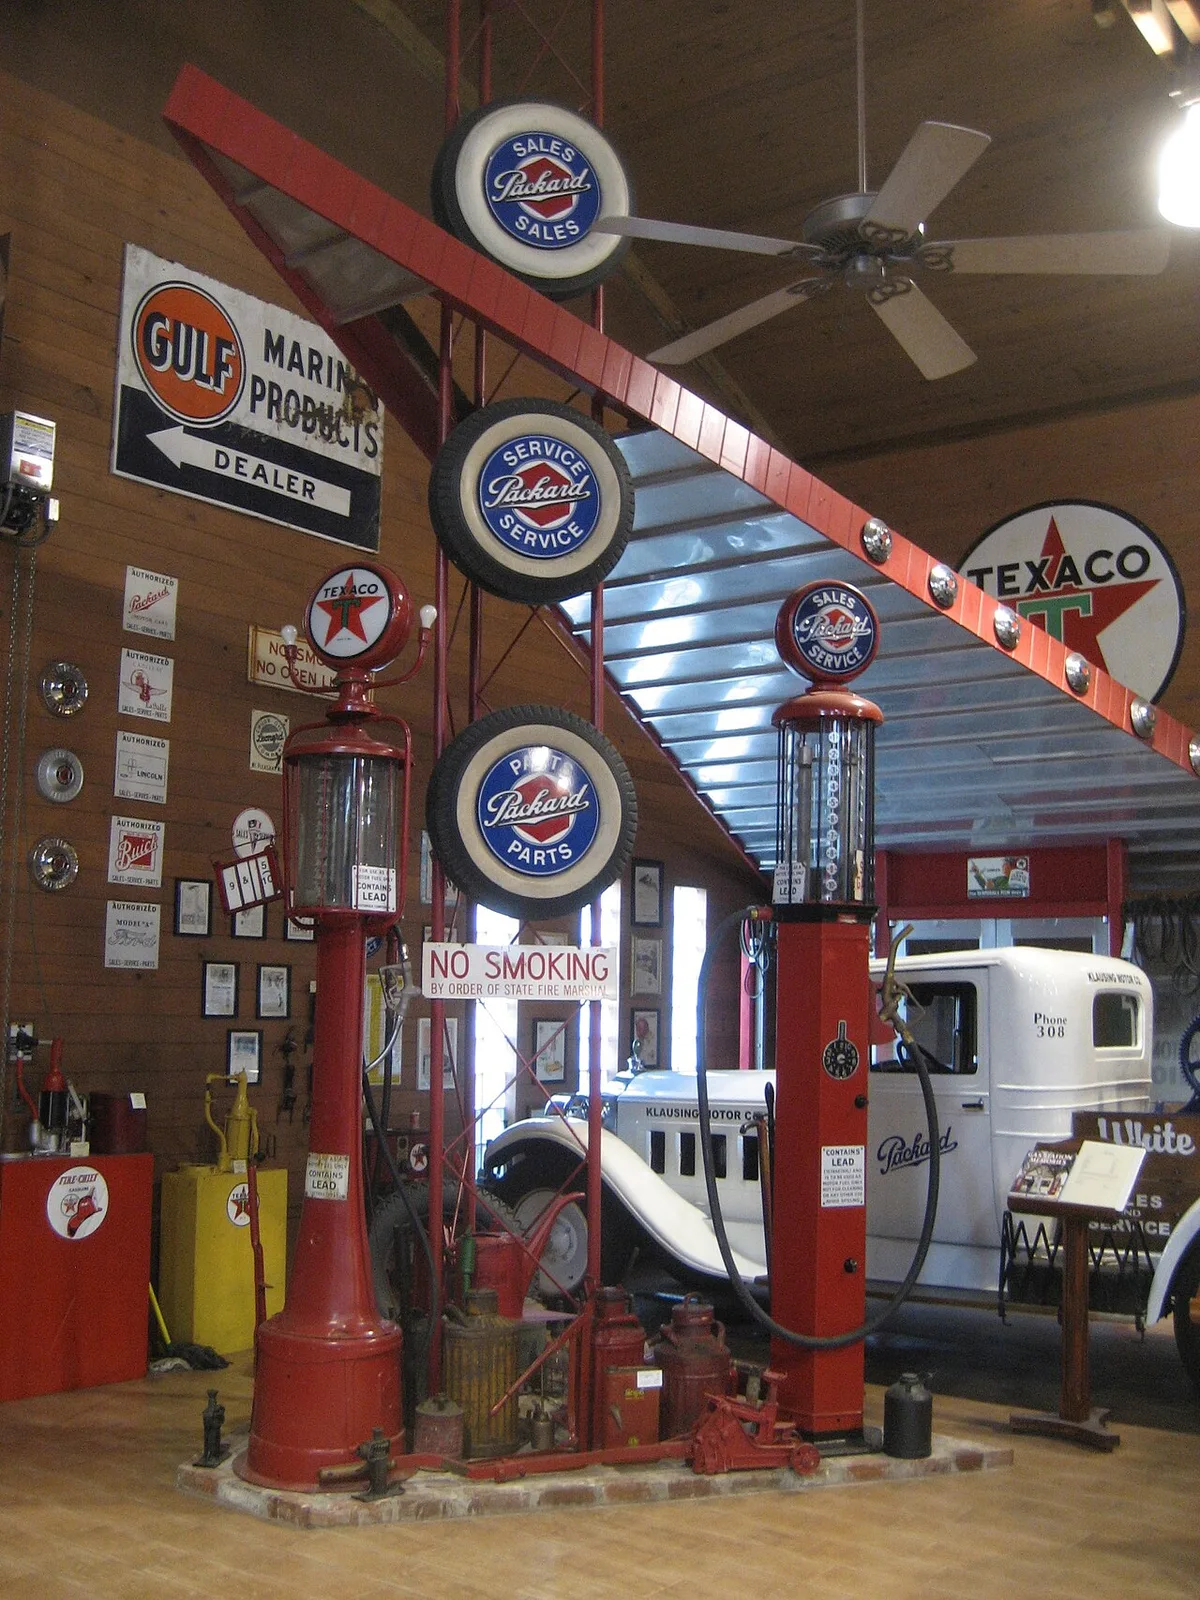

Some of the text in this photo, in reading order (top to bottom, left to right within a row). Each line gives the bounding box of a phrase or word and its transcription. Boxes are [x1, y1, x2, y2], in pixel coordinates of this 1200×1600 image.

[512, 136, 575, 163] SALES
[491, 168, 591, 202] Packard
[515, 215, 580, 240] SALES
[142, 311, 236, 396] GULF
[263, 328, 352, 394] MARIN
[249, 373, 379, 459] PRODUCTS
[503, 440, 587, 477] SERVICE
[214, 449, 316, 501] DEALER
[484, 474, 591, 510] Packard
[499, 514, 584, 549] SERVICE
[131, 569, 174, 587] AUTHORIZED
[966, 544, 1151, 597] TEXACO
[128, 586, 169, 614] Packard
[323, 583, 379, 599] TEXACO
[812, 591, 856, 609] SALES
[799, 616, 872, 643] Packard
[125, 650, 170, 666] AUTHORIZED
[808, 645, 863, 669] SERVICE
[257, 659, 276, 676] NO
[123, 735, 166, 748] AUTHORIZED
[137, 770, 163, 781] LINCOLN
[484, 784, 589, 827] Packard
[117, 820, 161, 832] AUTHORIZED
[115, 832, 158, 872] Buick
[507, 840, 572, 866] PARTS
[261, 861, 267, 870] 5
[229, 876, 249, 890] 9 &
[780, 887, 797, 895] LED
[362, 892, 387, 902] LEAD
[112, 902, 157, 913] AUTHORIZED
[116, 919, 140, 928] MODEL
[107, 928, 157, 949] Ford
[430, 950, 609, 982] NO SMOKING
[1088, 972, 1117, 983] KLAUSING
[431, 983, 607, 997] BY ORDER OF STATE FIRE MARSHAL
[1034, 1012, 1068, 1025] Phone
[1036, 1026, 1065, 1038] 308
[646, 1107, 699, 1118] KLAUSING
[708, 1109, 741, 1120] OTOR
[826, 1148, 860, 1156] CONTAINS
[877, 1126, 958, 1175] Packad
[831, 1158, 854, 1167] LEAD
[309, 1169, 344, 1179] CONTAINS
[312, 1180, 337, 1190] LEAD
